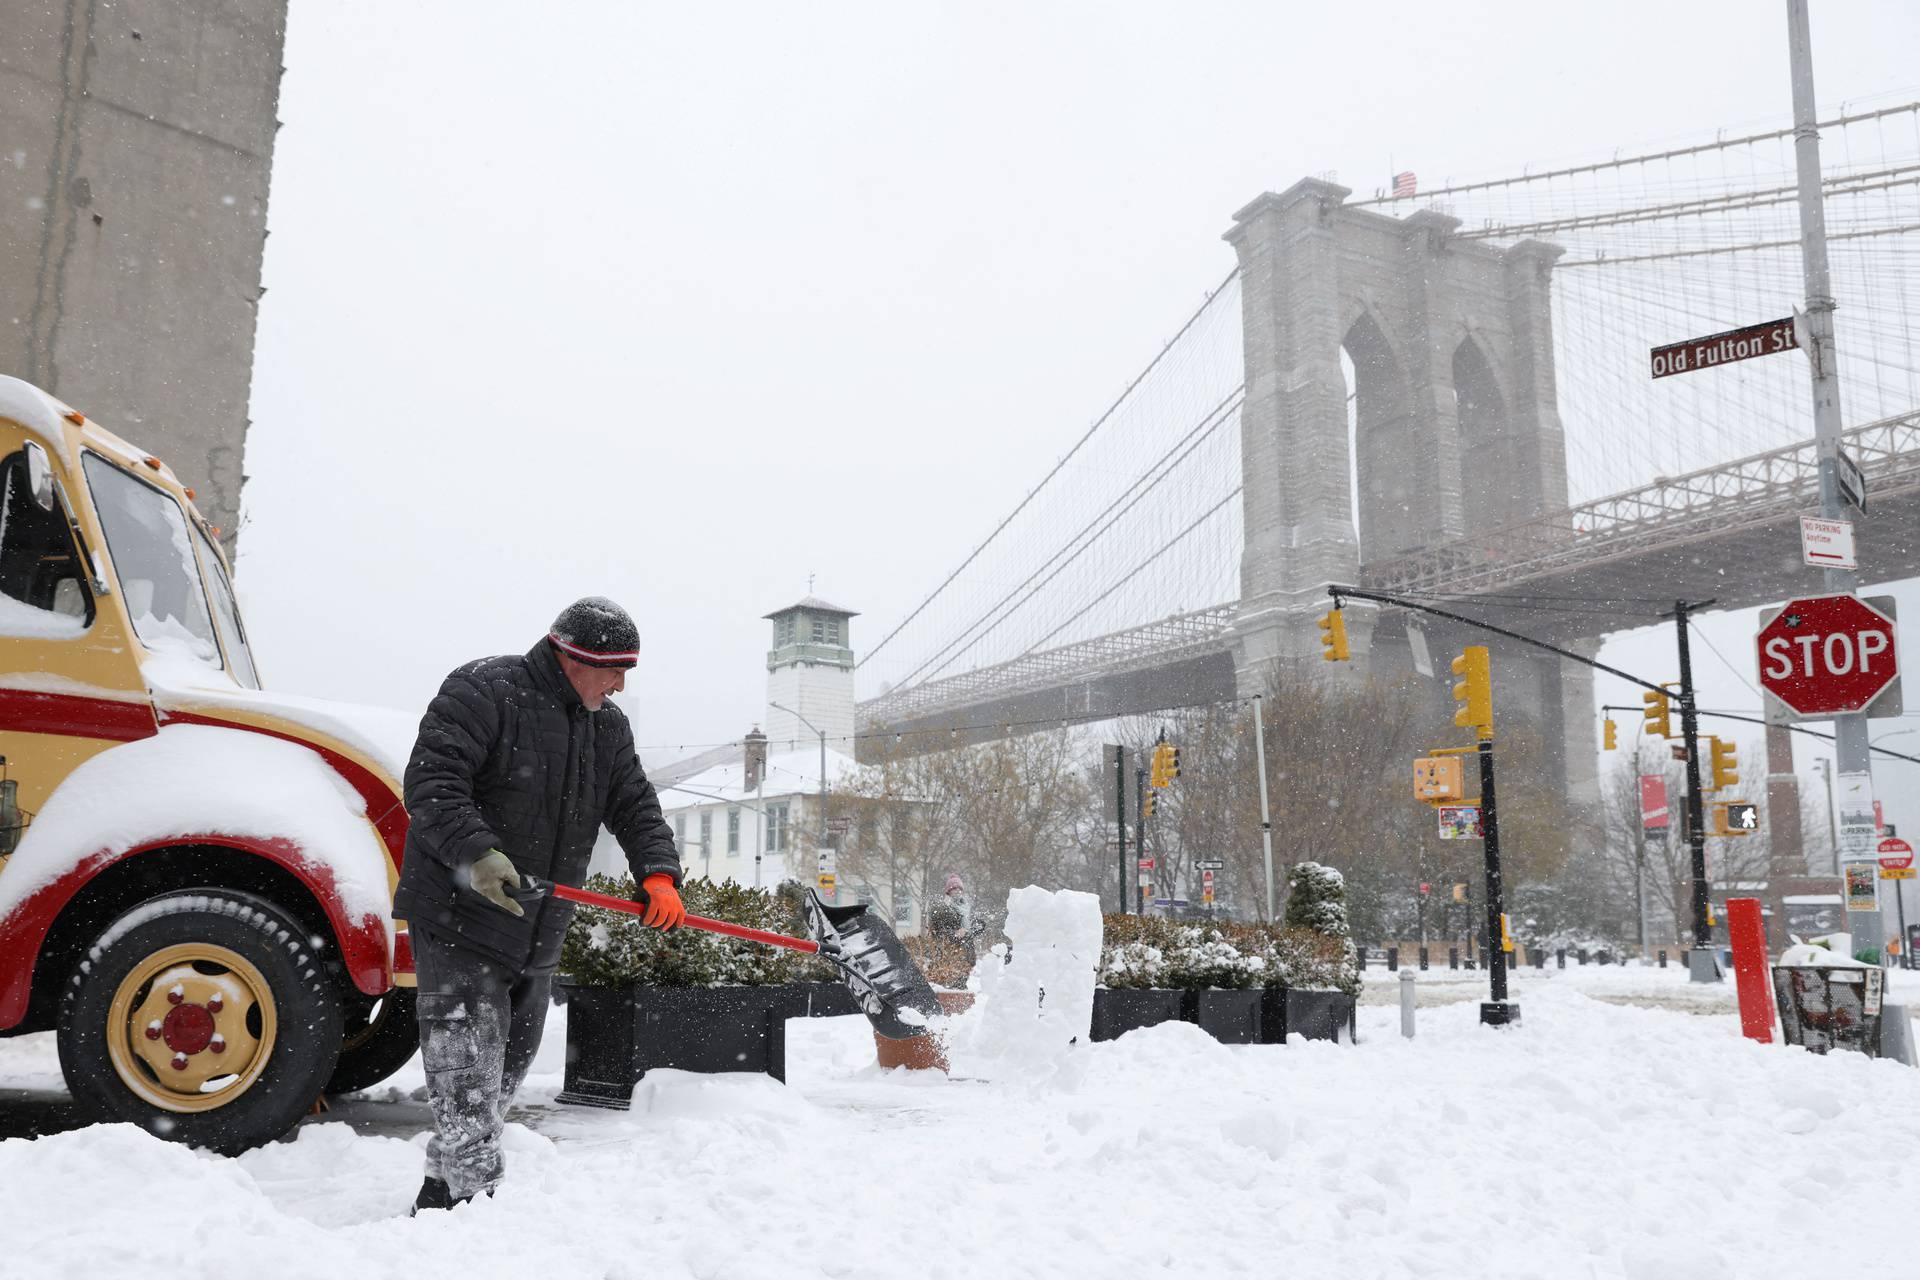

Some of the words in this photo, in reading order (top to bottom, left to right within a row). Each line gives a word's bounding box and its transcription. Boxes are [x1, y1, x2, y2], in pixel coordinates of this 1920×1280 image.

[1652, 349, 1687, 376] Old
[1695, 337, 1763, 367] Fulton
[1772, 327, 1793, 350] St
[1804, 522, 1814, 531] NO
[1815, 523, 1841, 534] PARKING
[1765, 630, 1887, 679] STOP
